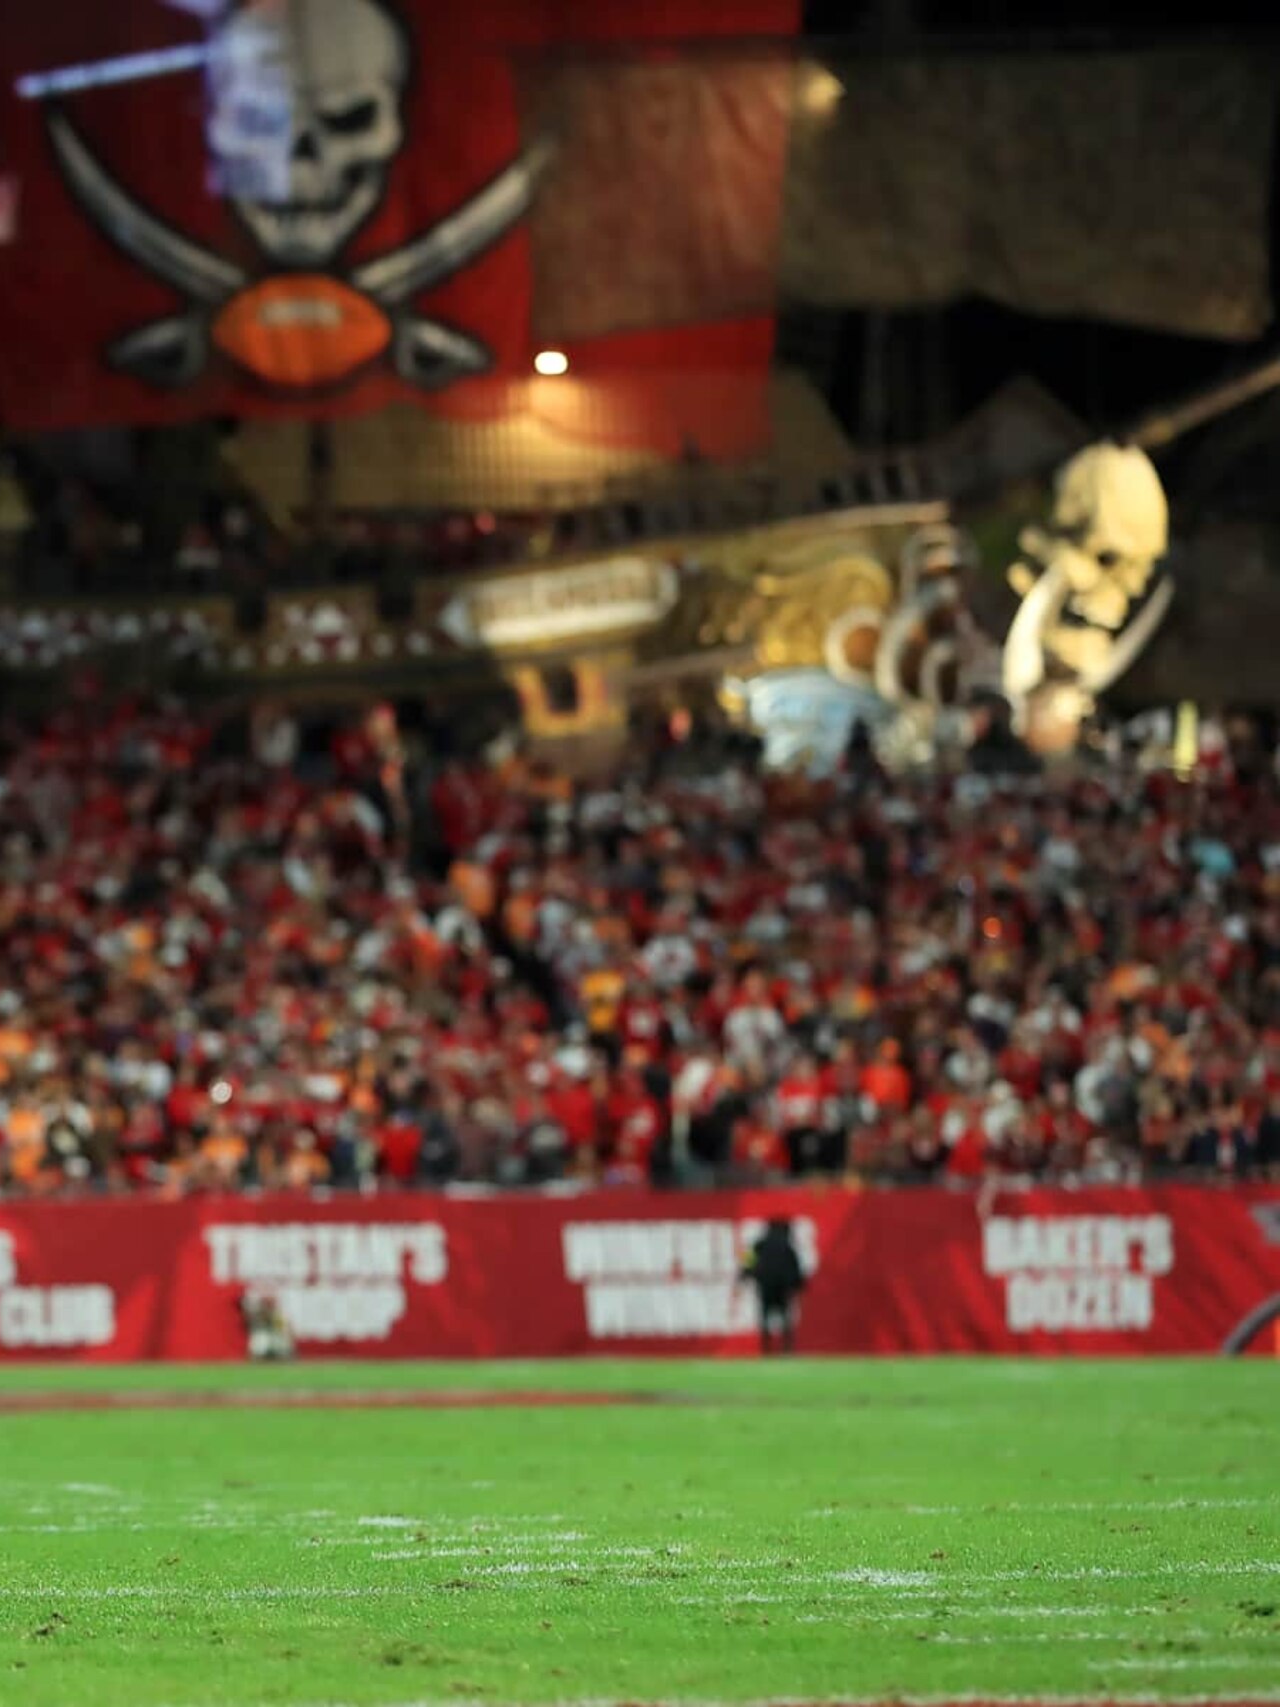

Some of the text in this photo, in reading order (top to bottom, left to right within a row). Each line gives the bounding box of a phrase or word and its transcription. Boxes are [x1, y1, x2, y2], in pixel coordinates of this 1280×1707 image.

[203, 1221, 448, 1286] TRISTAN'S
[984, 1214, 1174, 1278] BAKER'S
[1005, 1272, 1154, 1333] DOZEN
